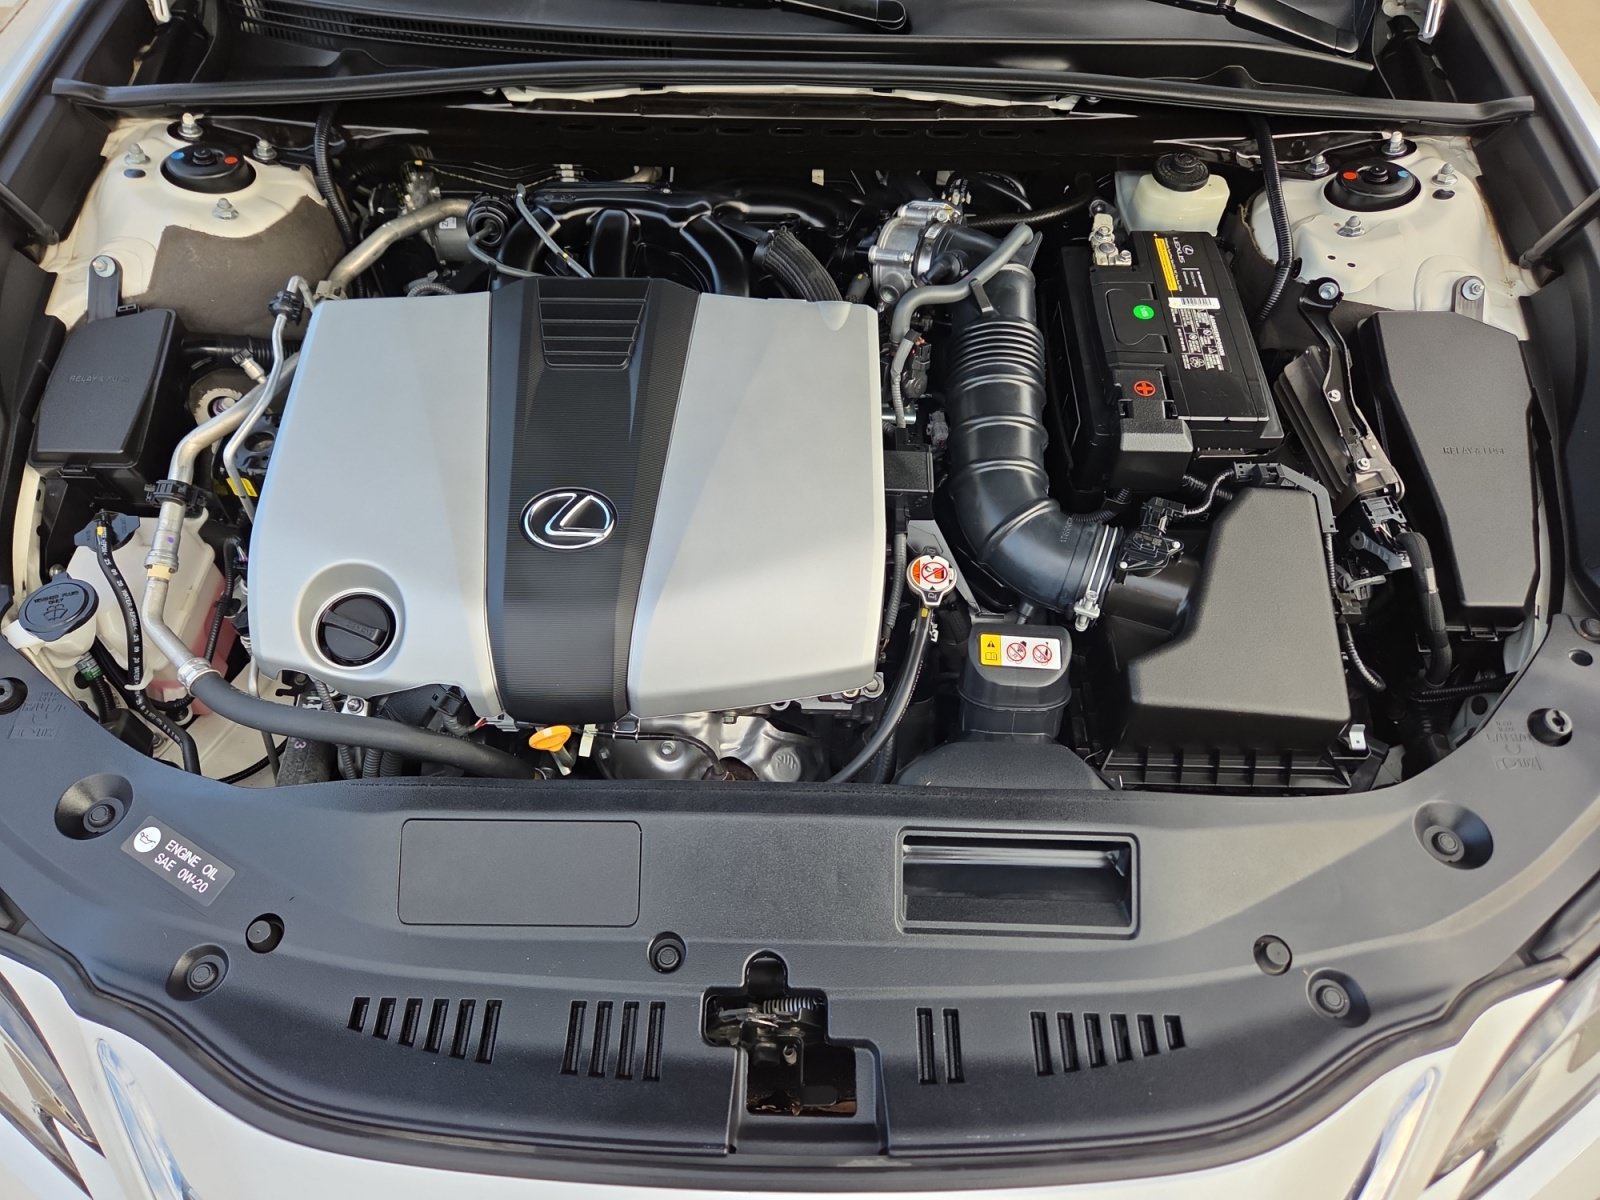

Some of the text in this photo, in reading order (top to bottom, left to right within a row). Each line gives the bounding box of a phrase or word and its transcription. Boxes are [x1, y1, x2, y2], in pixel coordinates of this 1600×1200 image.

[1173, 237, 1186, 264] LEXUS
[121, 589, 132, 607] WATER
[154, 852, 209, 893] SAE 0W-20
[164, 839, 219, 881] ENGINE OIL
